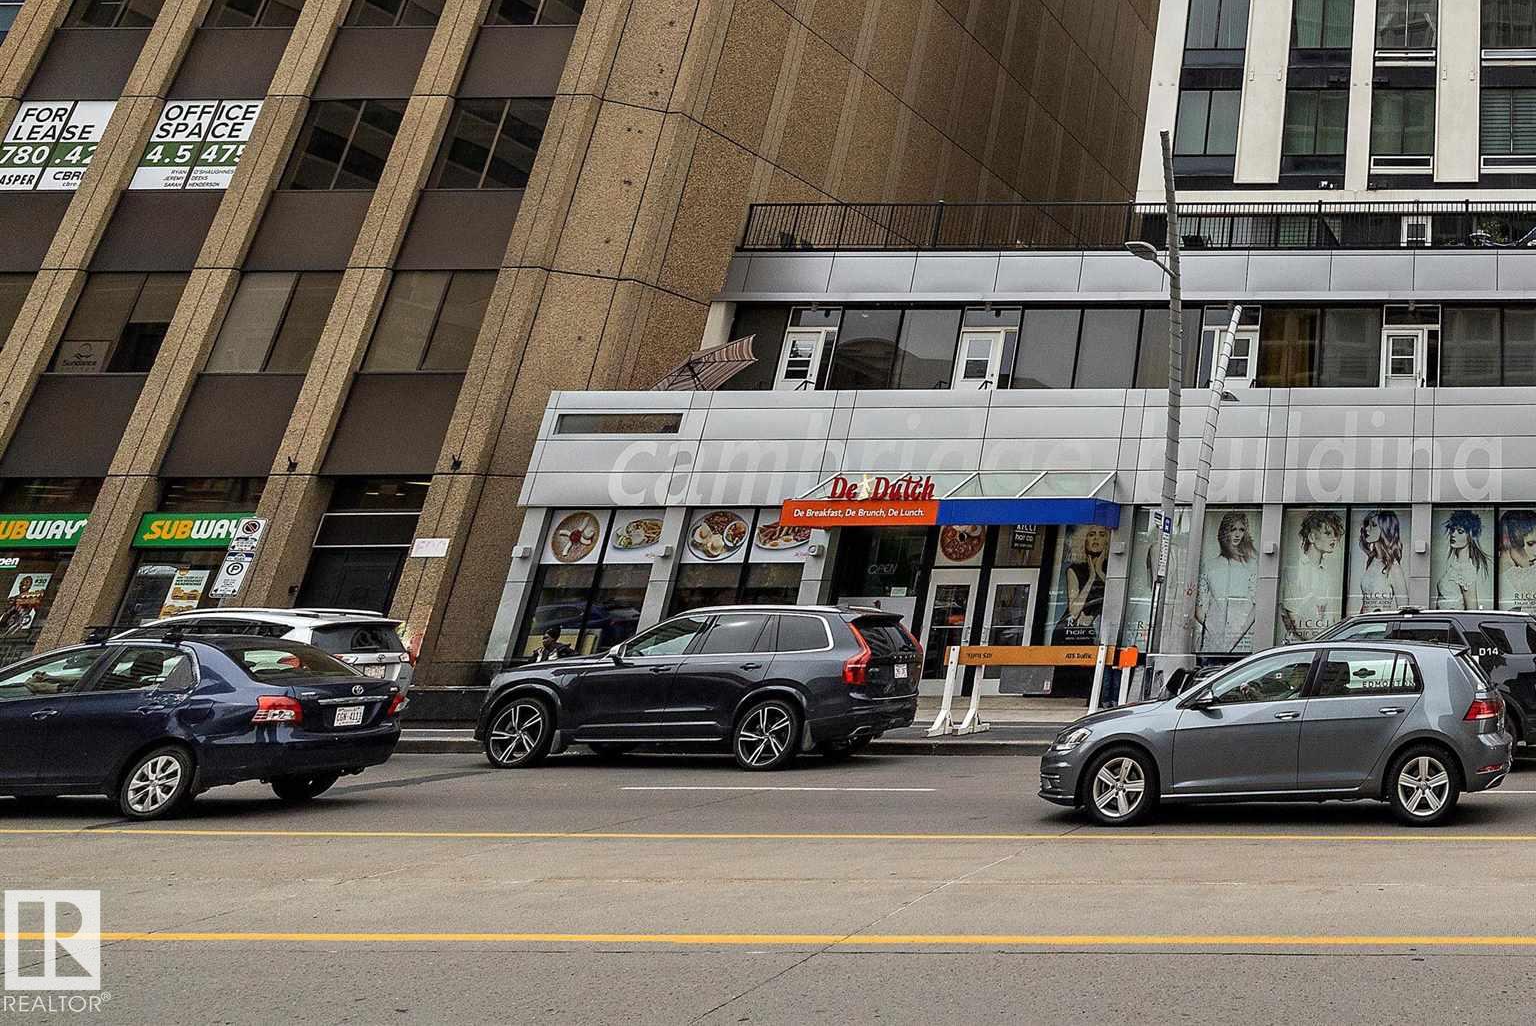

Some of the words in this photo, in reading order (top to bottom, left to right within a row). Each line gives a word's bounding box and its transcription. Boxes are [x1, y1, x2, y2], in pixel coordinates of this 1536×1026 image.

[21, 107, 69, 123] FOR
[165, 105, 259, 121] OFFICE
[12, 125, 95, 141] LEASE
[155, 122, 245, 139] SPACE
[53, 171, 84, 181] CBR
[829, 476, 858, 499] De
[871, 475, 936, 500] Dutch
[793, 508, 805, 518] De
[806, 508, 845, 518] Breakfast,
[845, 508, 856, 518] De
[857, 508, 887, 519] Brunch,
[888, 508, 899, 518] De
[900, 508, 925, 518] Lunch.
[1479, 647, 1499, 656] D14
